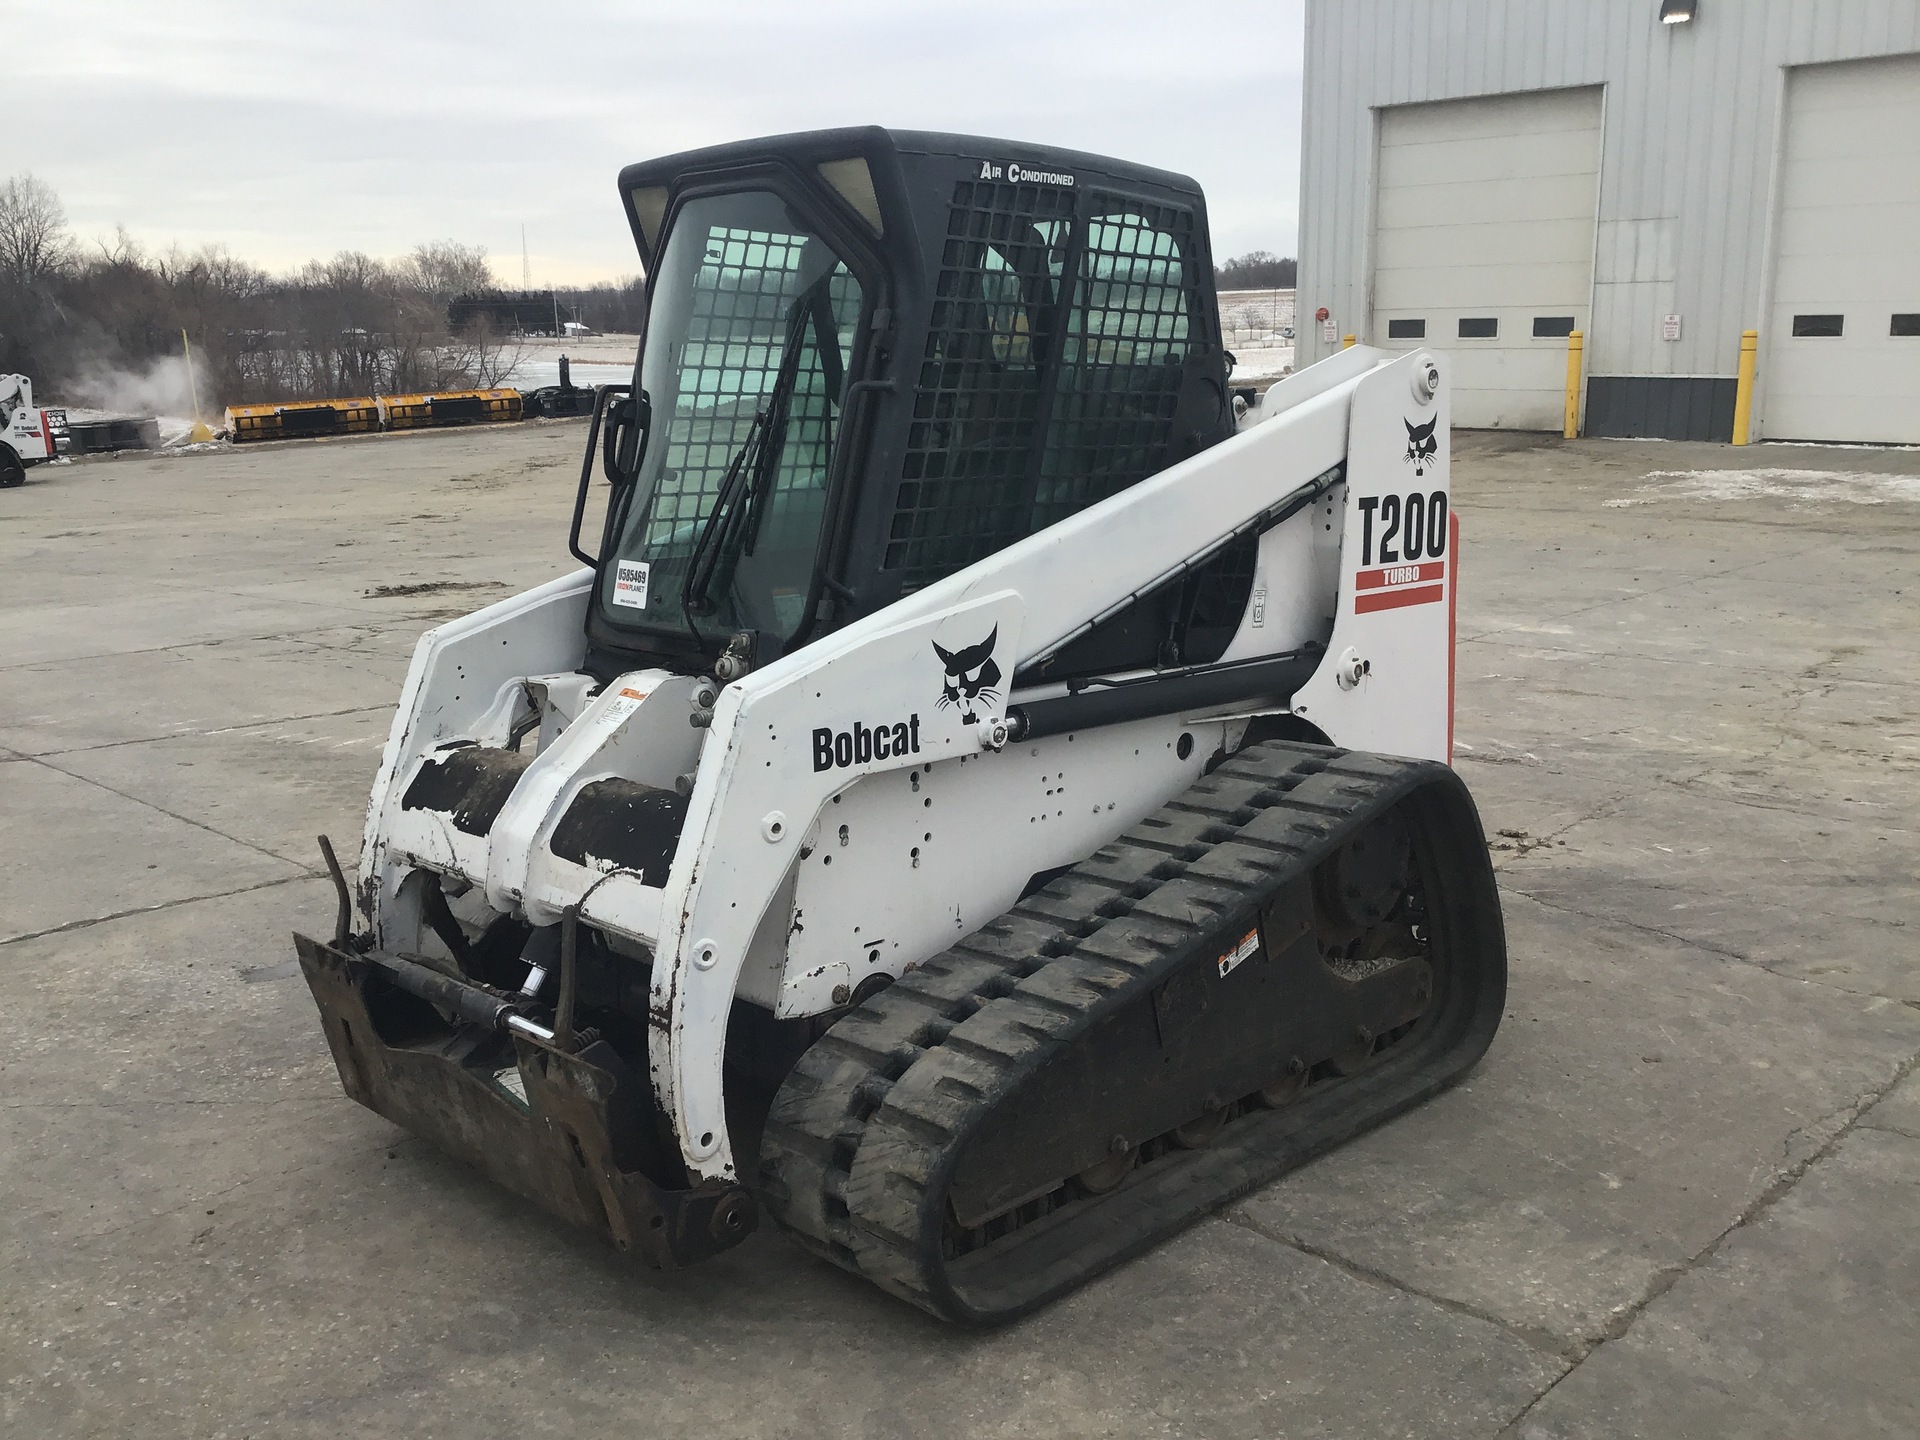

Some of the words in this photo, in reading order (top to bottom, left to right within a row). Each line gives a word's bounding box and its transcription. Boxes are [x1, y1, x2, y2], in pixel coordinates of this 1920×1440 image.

[1358, 490, 1448, 567] T200
[1383, 566, 1420, 586] TURBO
[812, 713, 920, 773] Bobcat
